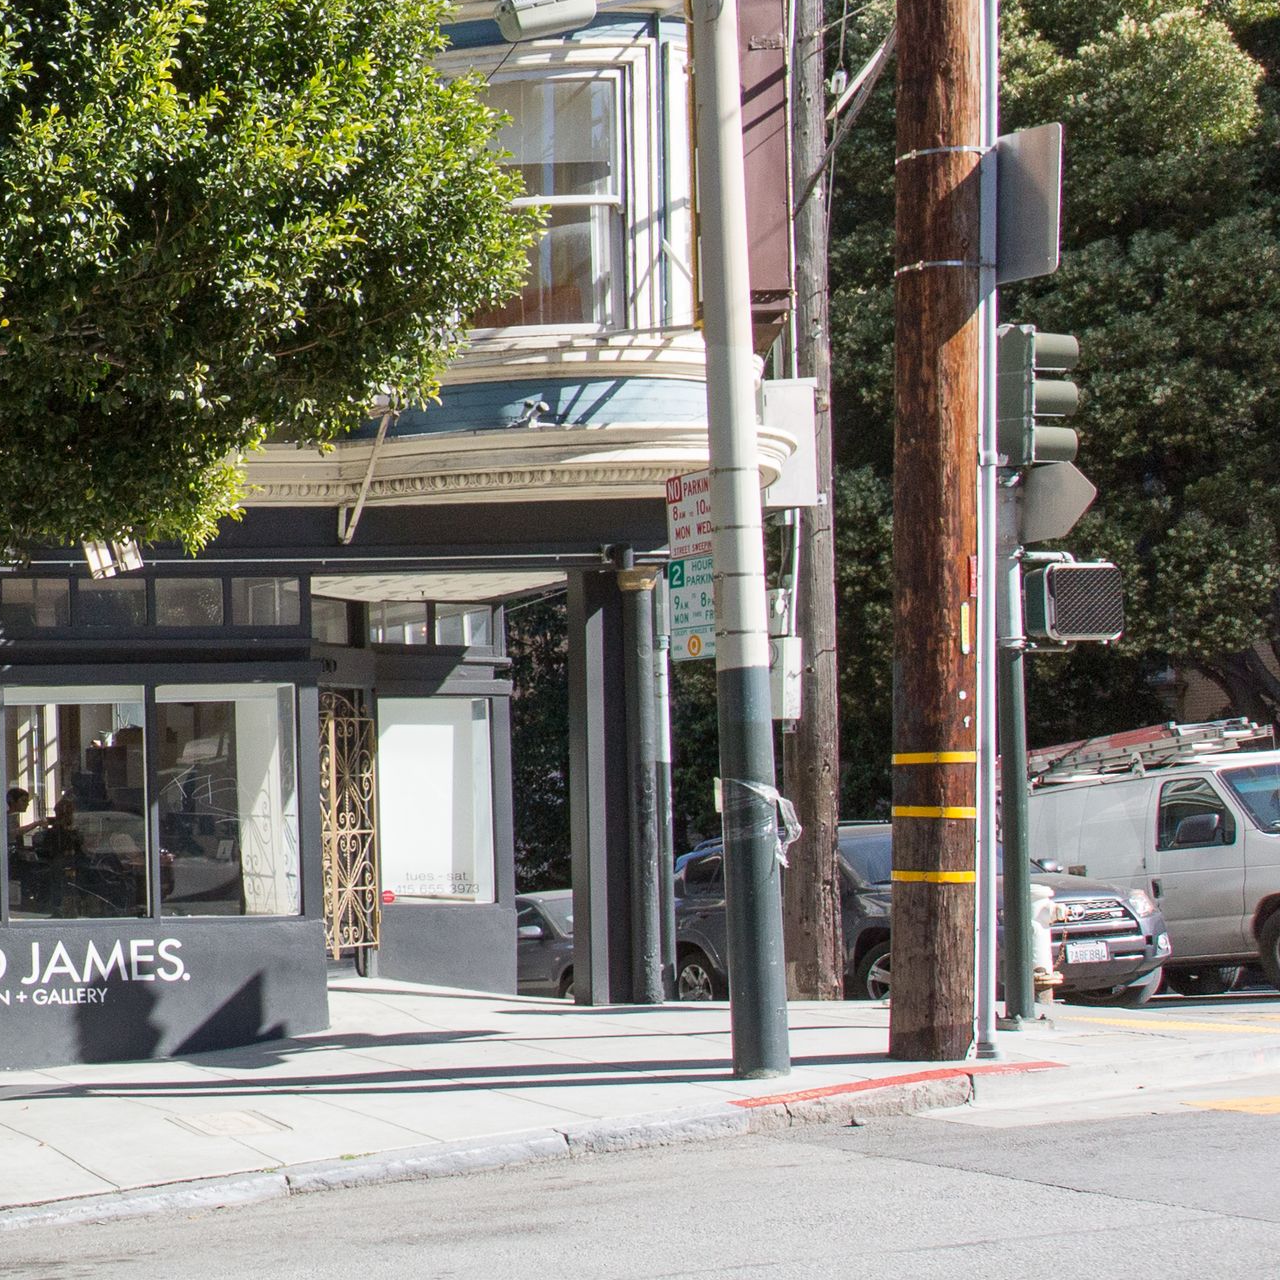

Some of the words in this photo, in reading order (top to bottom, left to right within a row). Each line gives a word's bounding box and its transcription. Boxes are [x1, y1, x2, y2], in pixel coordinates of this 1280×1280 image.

[668, 479, 680, 501] NO
[683, 478, 709, 496] PARKIN
[675, 525, 691, 540] MON
[673, 544, 690, 556] STREET
[691, 540, 712, 552] SWEEPIN
[691, 559, 713, 572] HOUR
[672, 565, 682, 586] 2
[686, 573, 714, 586] PARKIN
[674, 614, 689, 625] MON
[705, 610, 714, 621] FR
[449, 883, 480, 894] 3973
[20, 938, 191, 984] JAMES.
[32, 987, 108, 1006] GALLERY
